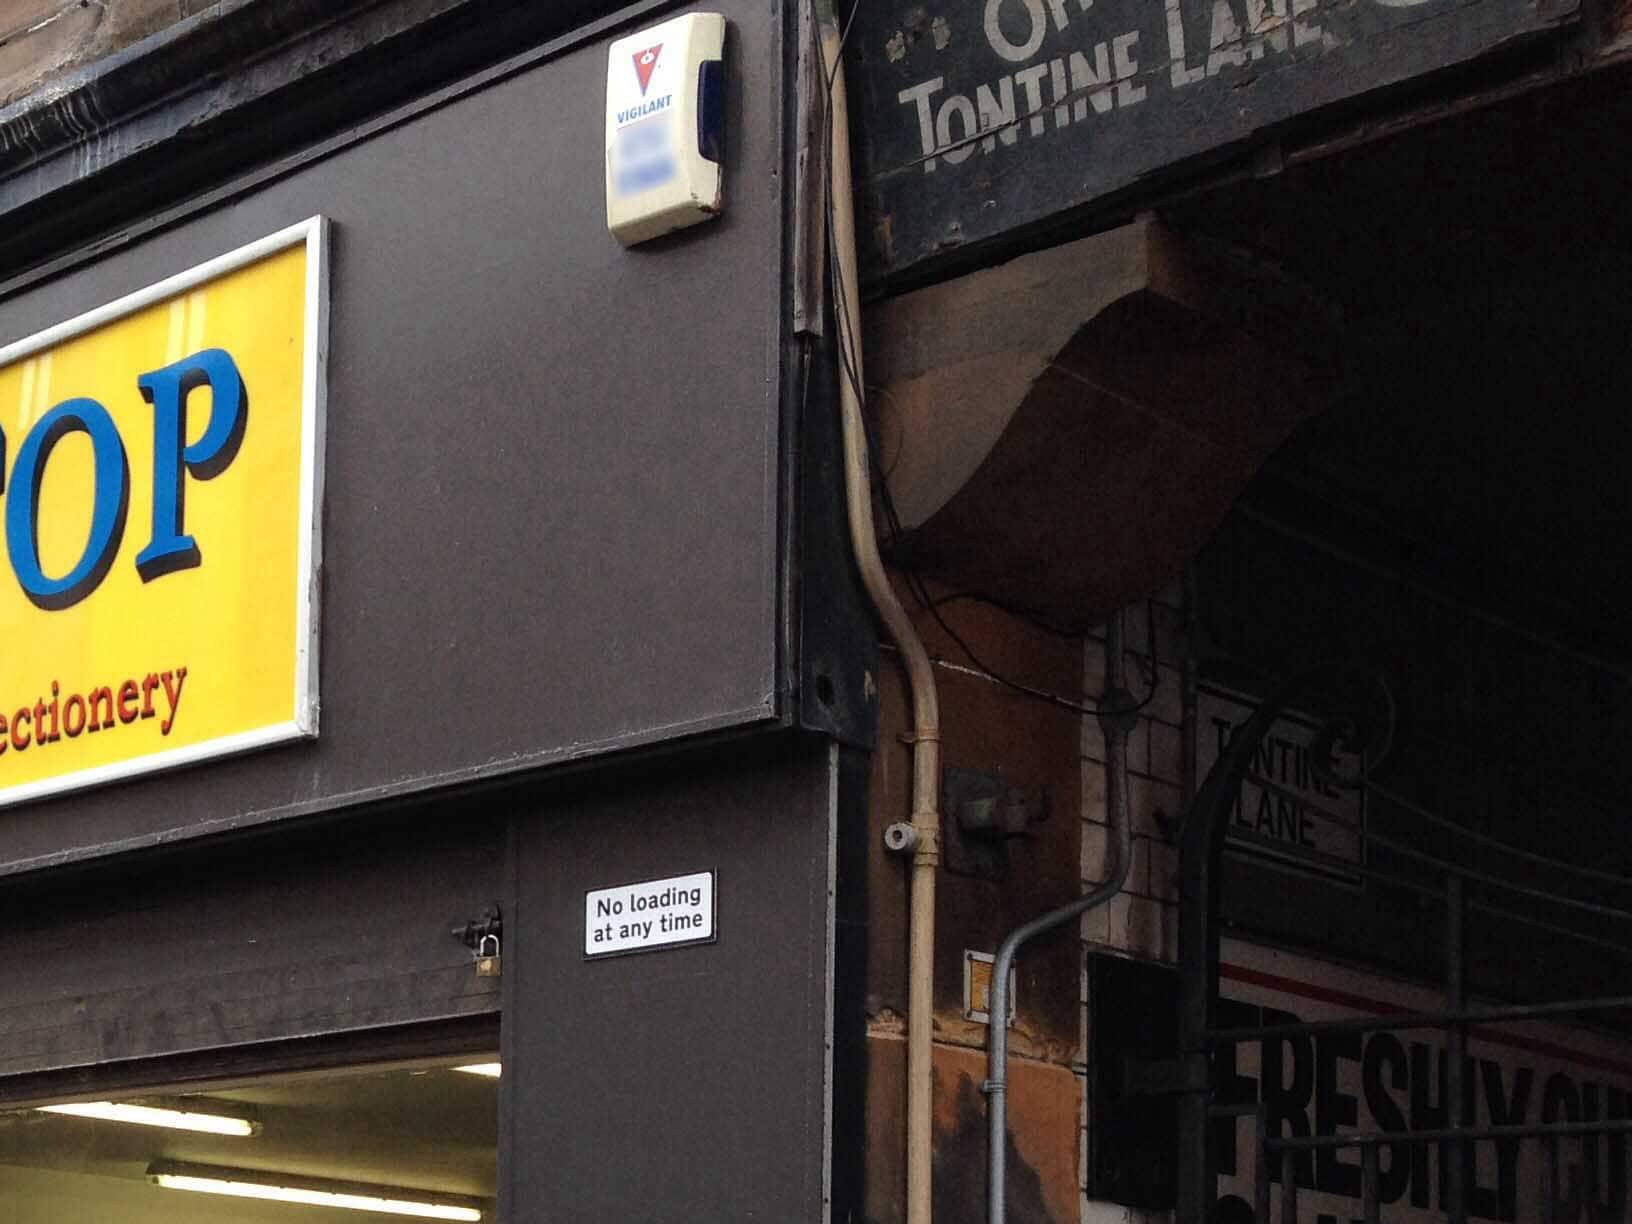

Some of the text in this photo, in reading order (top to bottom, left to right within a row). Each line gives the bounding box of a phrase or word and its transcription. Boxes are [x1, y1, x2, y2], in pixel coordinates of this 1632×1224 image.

[898, 0, 1340, 173] TONTINE LANE
[617, 94, 672, 123] VIGILANT
[1236, 790, 1315, 846] LANE
[597, 887, 701, 918] No loading
[594, 912, 703, 943] at any time
